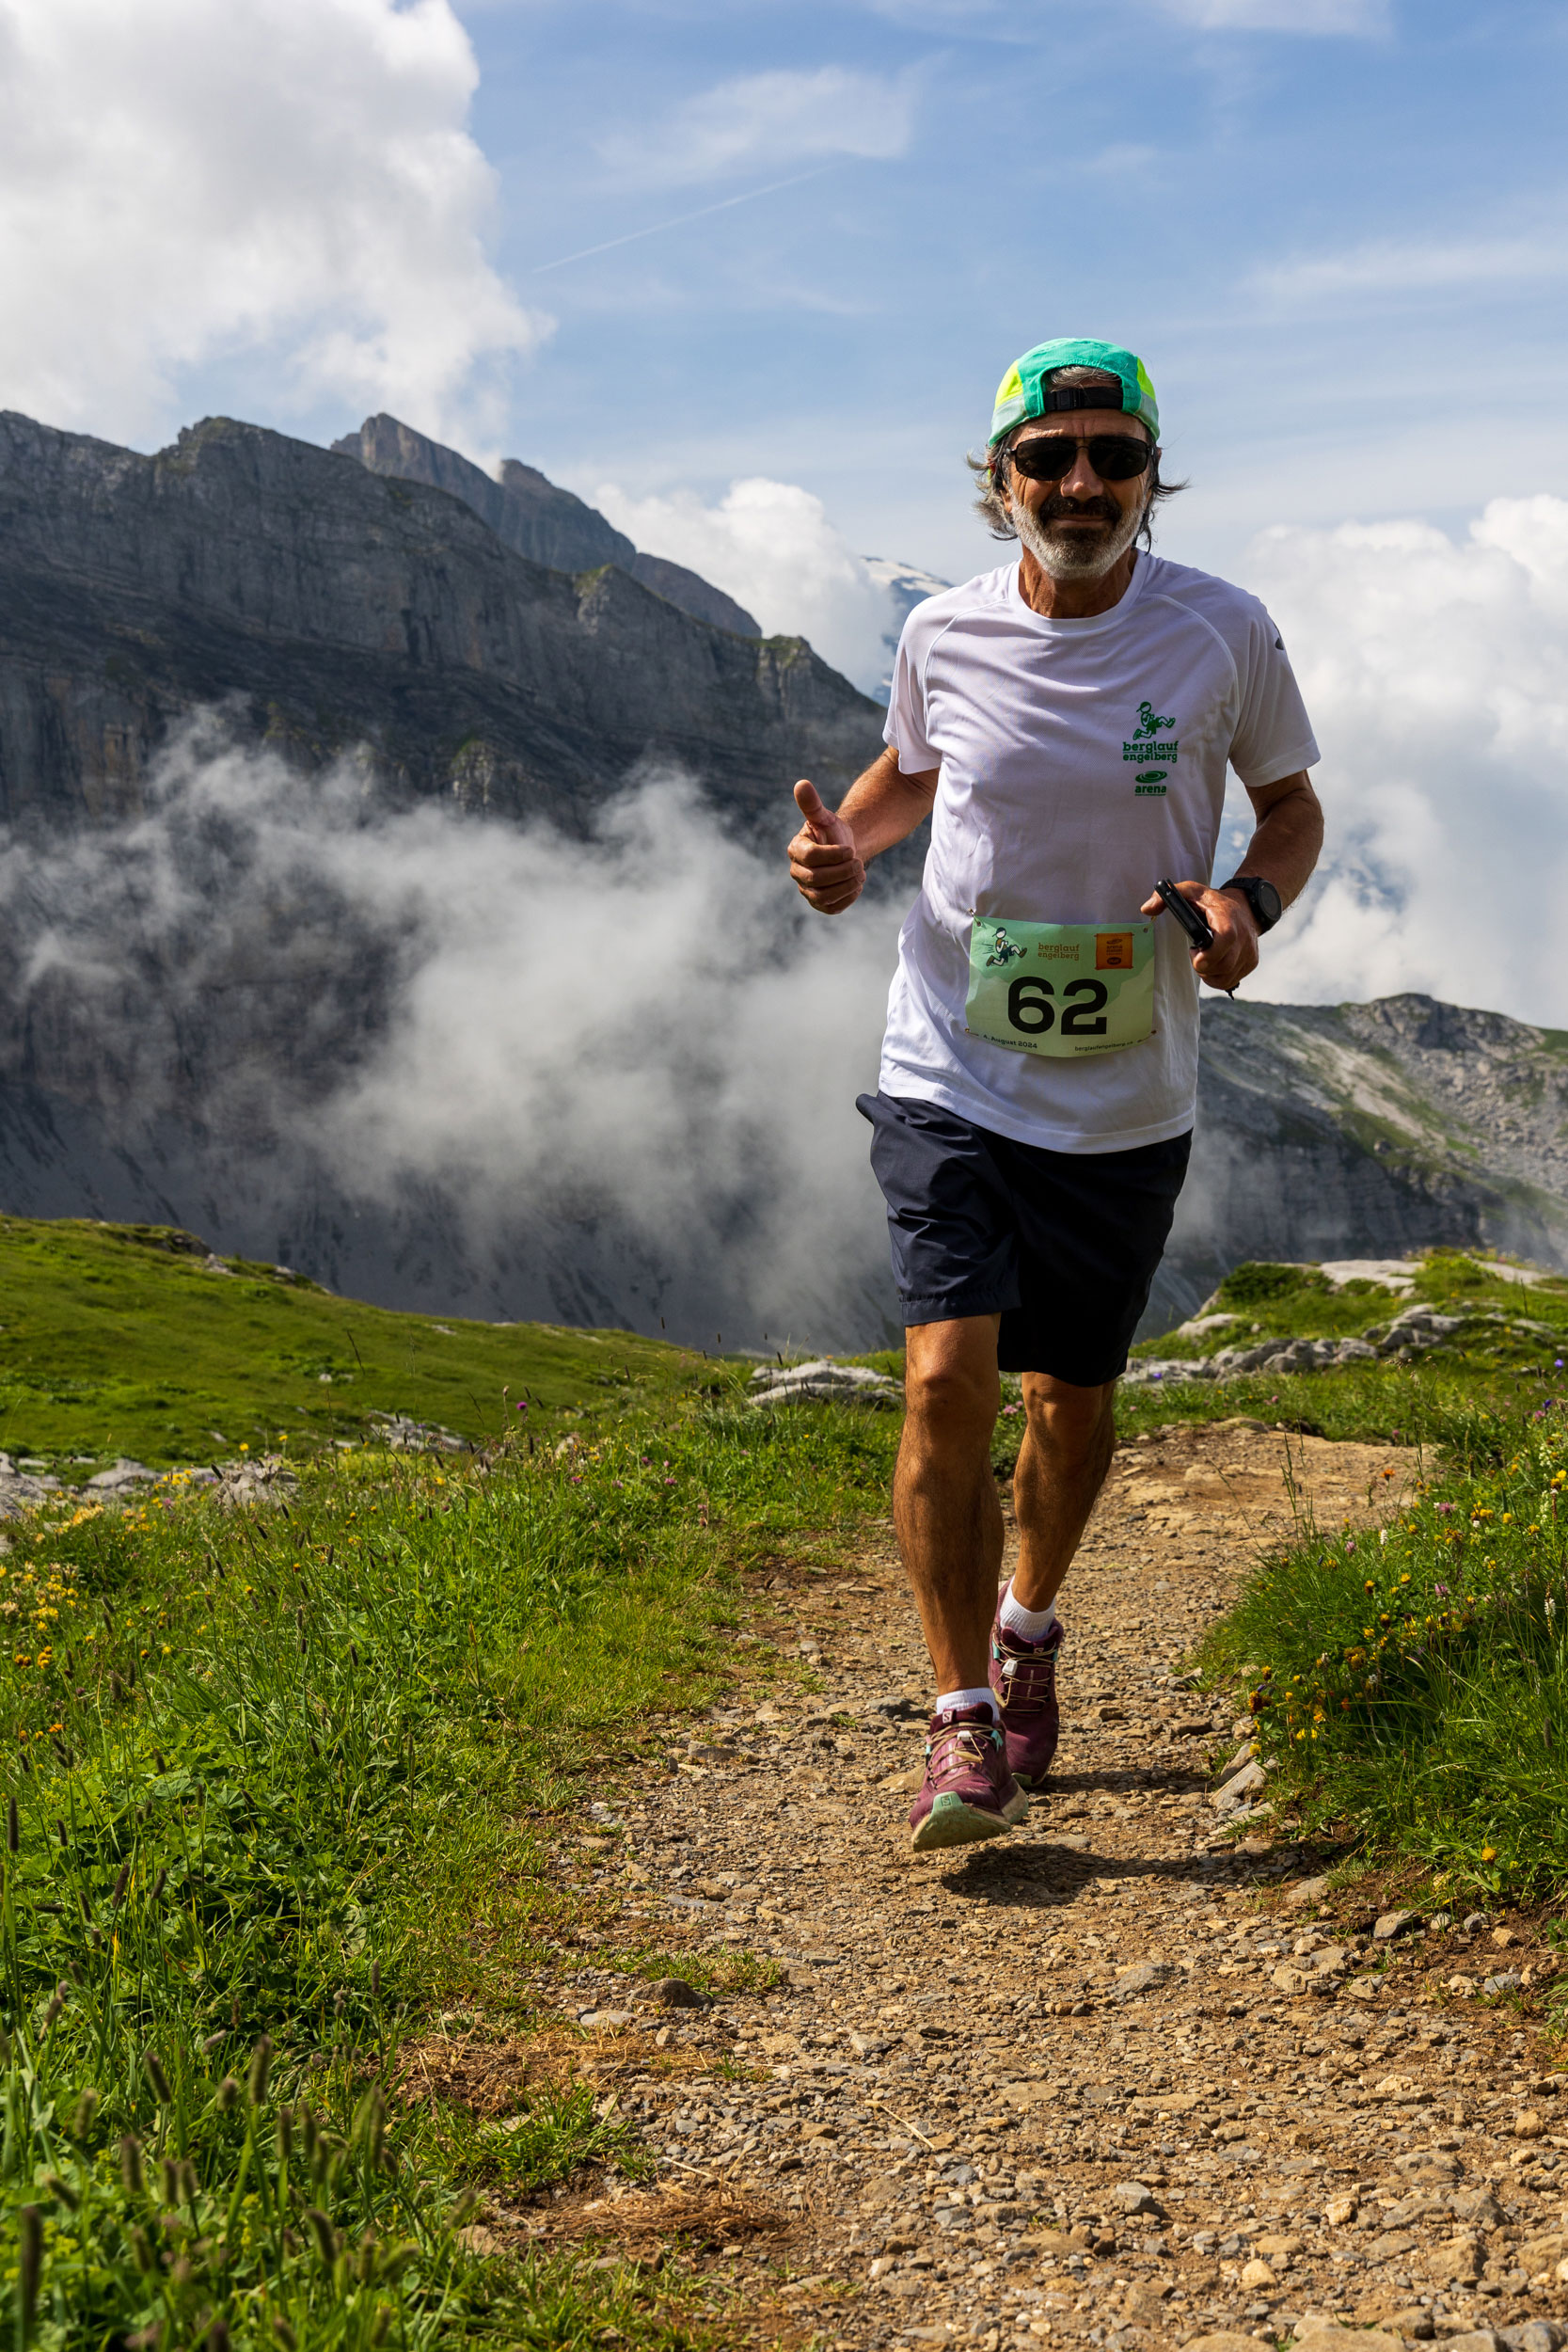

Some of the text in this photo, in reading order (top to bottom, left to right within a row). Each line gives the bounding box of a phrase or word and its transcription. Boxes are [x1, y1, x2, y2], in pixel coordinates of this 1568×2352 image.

[1122, 740, 1179, 754] berglauf
[1122, 753, 1178, 763] engelberg
[1134, 785, 1167, 793] arena
[1037, 943, 1080, 953] berglauf
[1037, 951, 1080, 961] engelberg
[1007, 976, 1108, 1035] 62
[990, 1036, 1017, 1046] August
[1017, 1041, 1038, 1049] 2024
